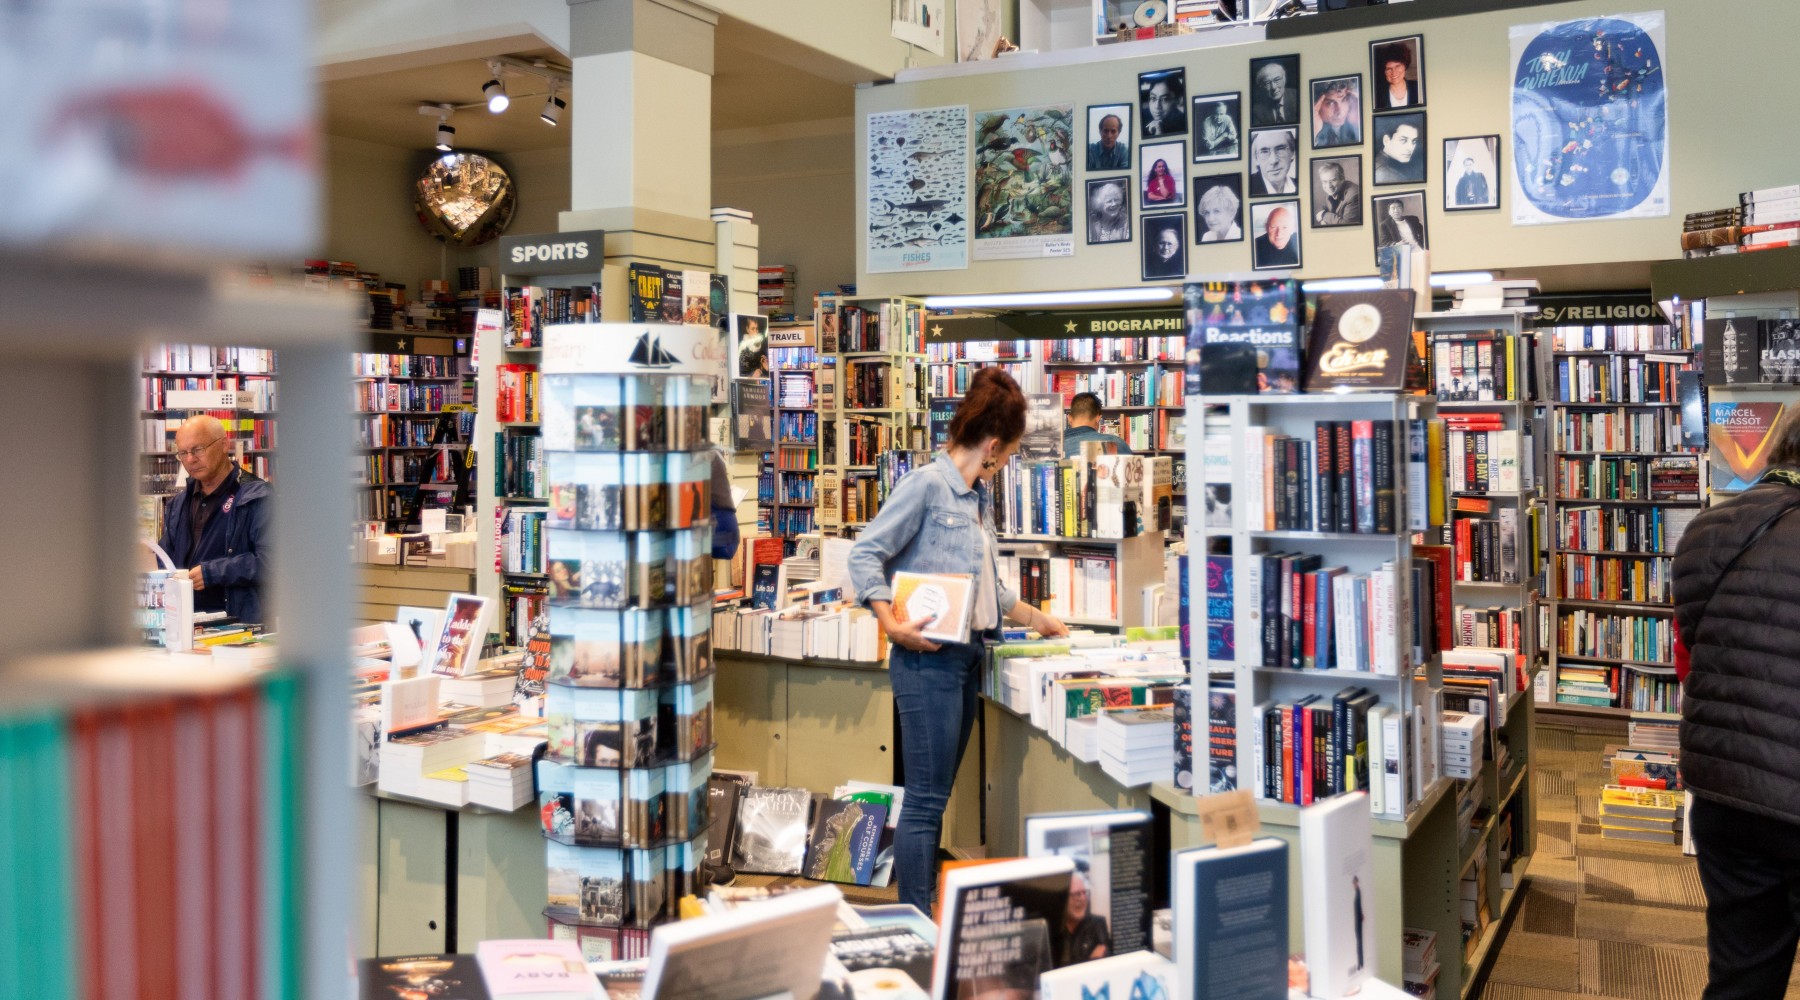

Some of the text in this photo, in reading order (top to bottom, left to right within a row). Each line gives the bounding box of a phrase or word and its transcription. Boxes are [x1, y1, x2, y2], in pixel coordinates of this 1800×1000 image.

[1519, 62, 1589, 92] WHENUA
[511, 241, 589, 263] SPORTS
[902, 252, 932, 263] FISHES
[1090, 318, 1185, 332] BIOGRAPHI
[770, 333, 802, 341] TRAVEL
[1206, 327, 1293, 344] Reactions
[1319, 342, 1390, 373] Edison
[1186, 374, 1200, 382] THE
[1715, 408, 1756, 417] MARCEL
[1715, 417, 1762, 425] CHASSOT
[936, 432, 948, 442] THE
[1476, 454, 1488, 480] D-DAY
[1489, 458, 1498, 479] PARIS
[494, 517, 502, 563] FOOTBALL
[755, 584, 775, 593] Life 3.0
[1375, 599, 1382, 607] of
[1374, 608, 1382, 632] Policing
[1462, 613, 1473, 647] DUNKIRK
[441, 634, 465, 645] to the
[535, 655, 544, 667] TO
[1282, 712, 1292, 750] DENIAL
[1326, 744, 1334, 763] RED
[752, 791, 796, 803] ASTON
[748, 801, 802, 814] MARTIN
[856, 814, 875, 872] GOLF COURSES
[864, 824, 878, 862] REMARKABLE
